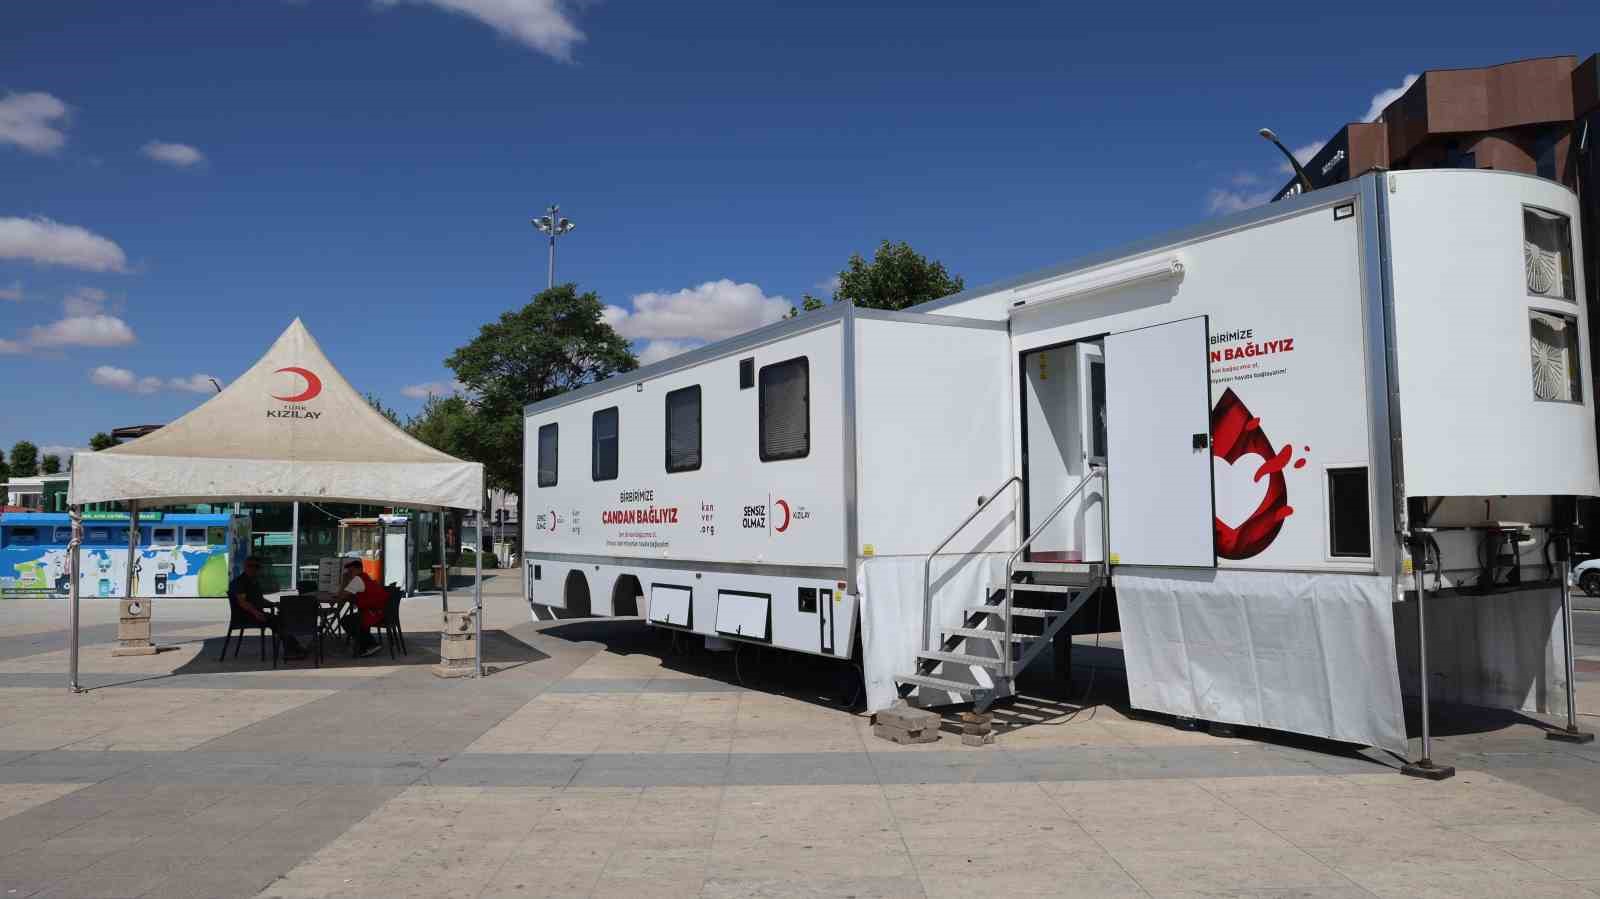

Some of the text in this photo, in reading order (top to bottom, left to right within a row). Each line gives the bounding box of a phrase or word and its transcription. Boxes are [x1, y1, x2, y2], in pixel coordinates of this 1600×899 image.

[1210, 329, 1253, 345] BİRİMİZE
[1210, 338, 1294, 363] N BAĞLIYIZ
[266, 410, 321, 419] KIZILAY
[620, 489, 654, 503] BİRBİRİMİZE
[701, 499, 714, 512] kan
[743, 505, 766, 517] SENSİZ
[602, 509, 634, 525] CANDAN
[637, 504, 678, 524] BAĞLIYIZ
[742, 518, 766, 528] OLMAZ
